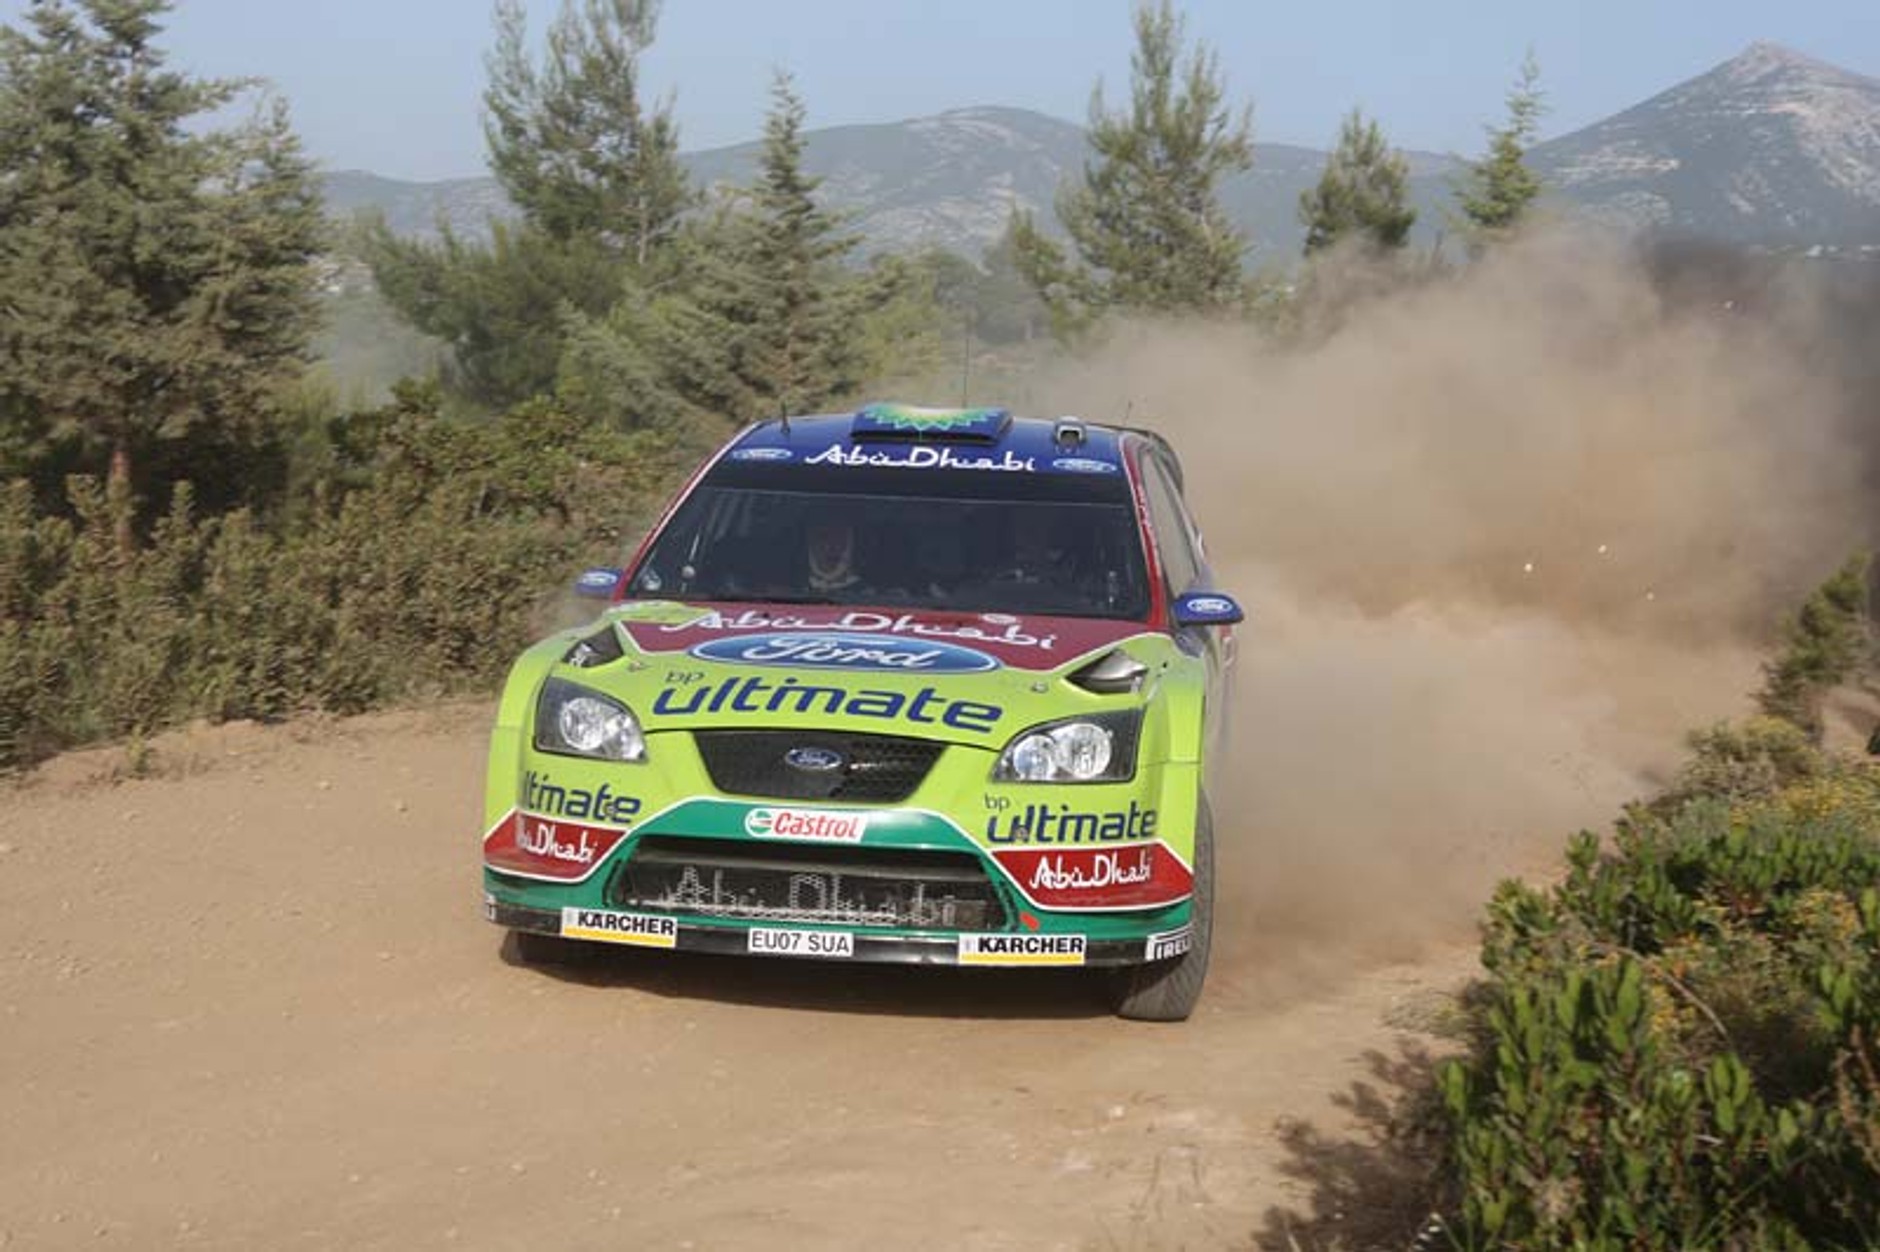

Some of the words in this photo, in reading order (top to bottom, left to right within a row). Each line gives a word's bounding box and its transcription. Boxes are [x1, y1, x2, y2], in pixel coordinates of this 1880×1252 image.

[804, 444, 893, 466] Abu
[908, 446, 1036, 471] Dhabi
[660, 610, 806, 633] Abu
[838, 612, 1057, 650] Dhabi
[742, 637, 943, 667] Ford
[665, 671, 704, 685] bp
[653, 676, 1003, 733] ultimate
[525, 769, 641, 823] ltimate
[985, 793, 1011, 813] bp
[774, 812, 859, 838] Castrol
[987, 800, 1156, 844] ultimate
[537, 822, 598, 863] Dhabi
[1029, 855, 1083, 890] Abu
[1094, 849, 1153, 887] Dhabi
[752, 930, 801, 950] EU07
[808, 932, 850, 953] SUA
